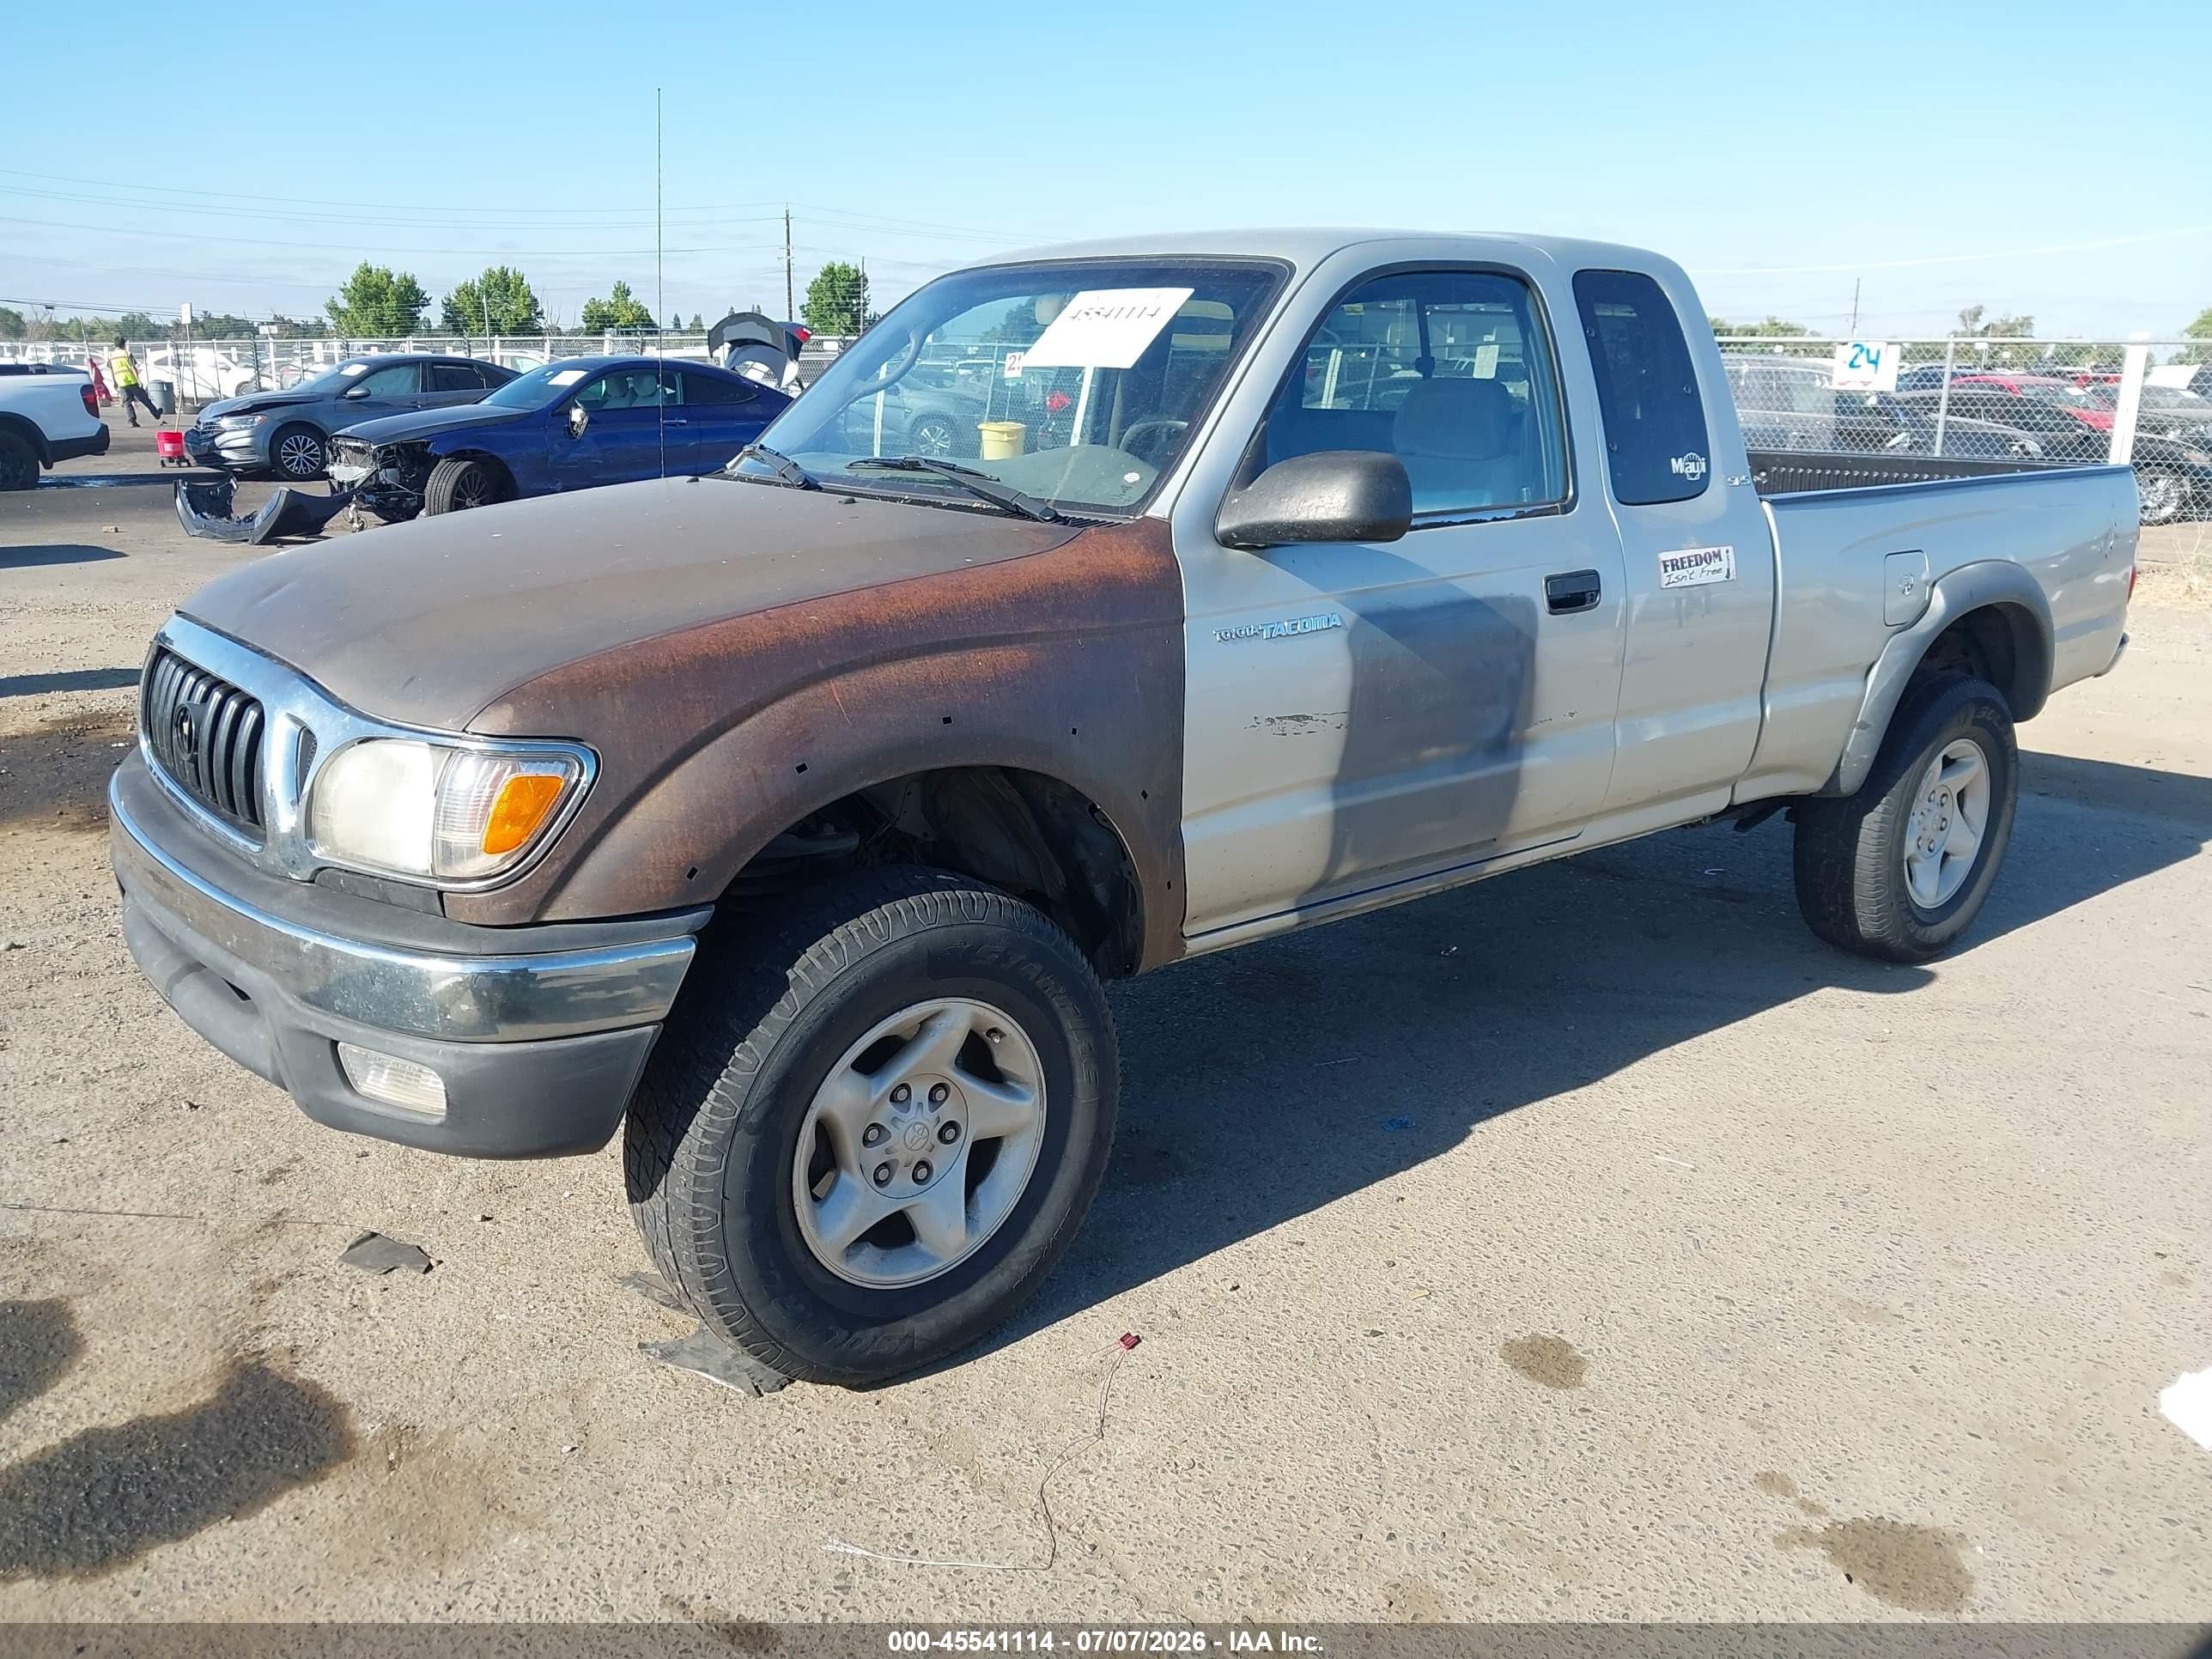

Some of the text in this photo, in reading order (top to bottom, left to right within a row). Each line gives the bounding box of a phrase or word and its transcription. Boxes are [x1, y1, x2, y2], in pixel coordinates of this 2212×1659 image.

[1849, 343, 1881, 374] 24
[1670, 457, 1707, 474] Maui
[1662, 550, 1723, 574] FREEDOM
[1664, 564, 1723, 586] Isn't Free
[1212, 612, 1342, 642] TOYOTA TACOMA
